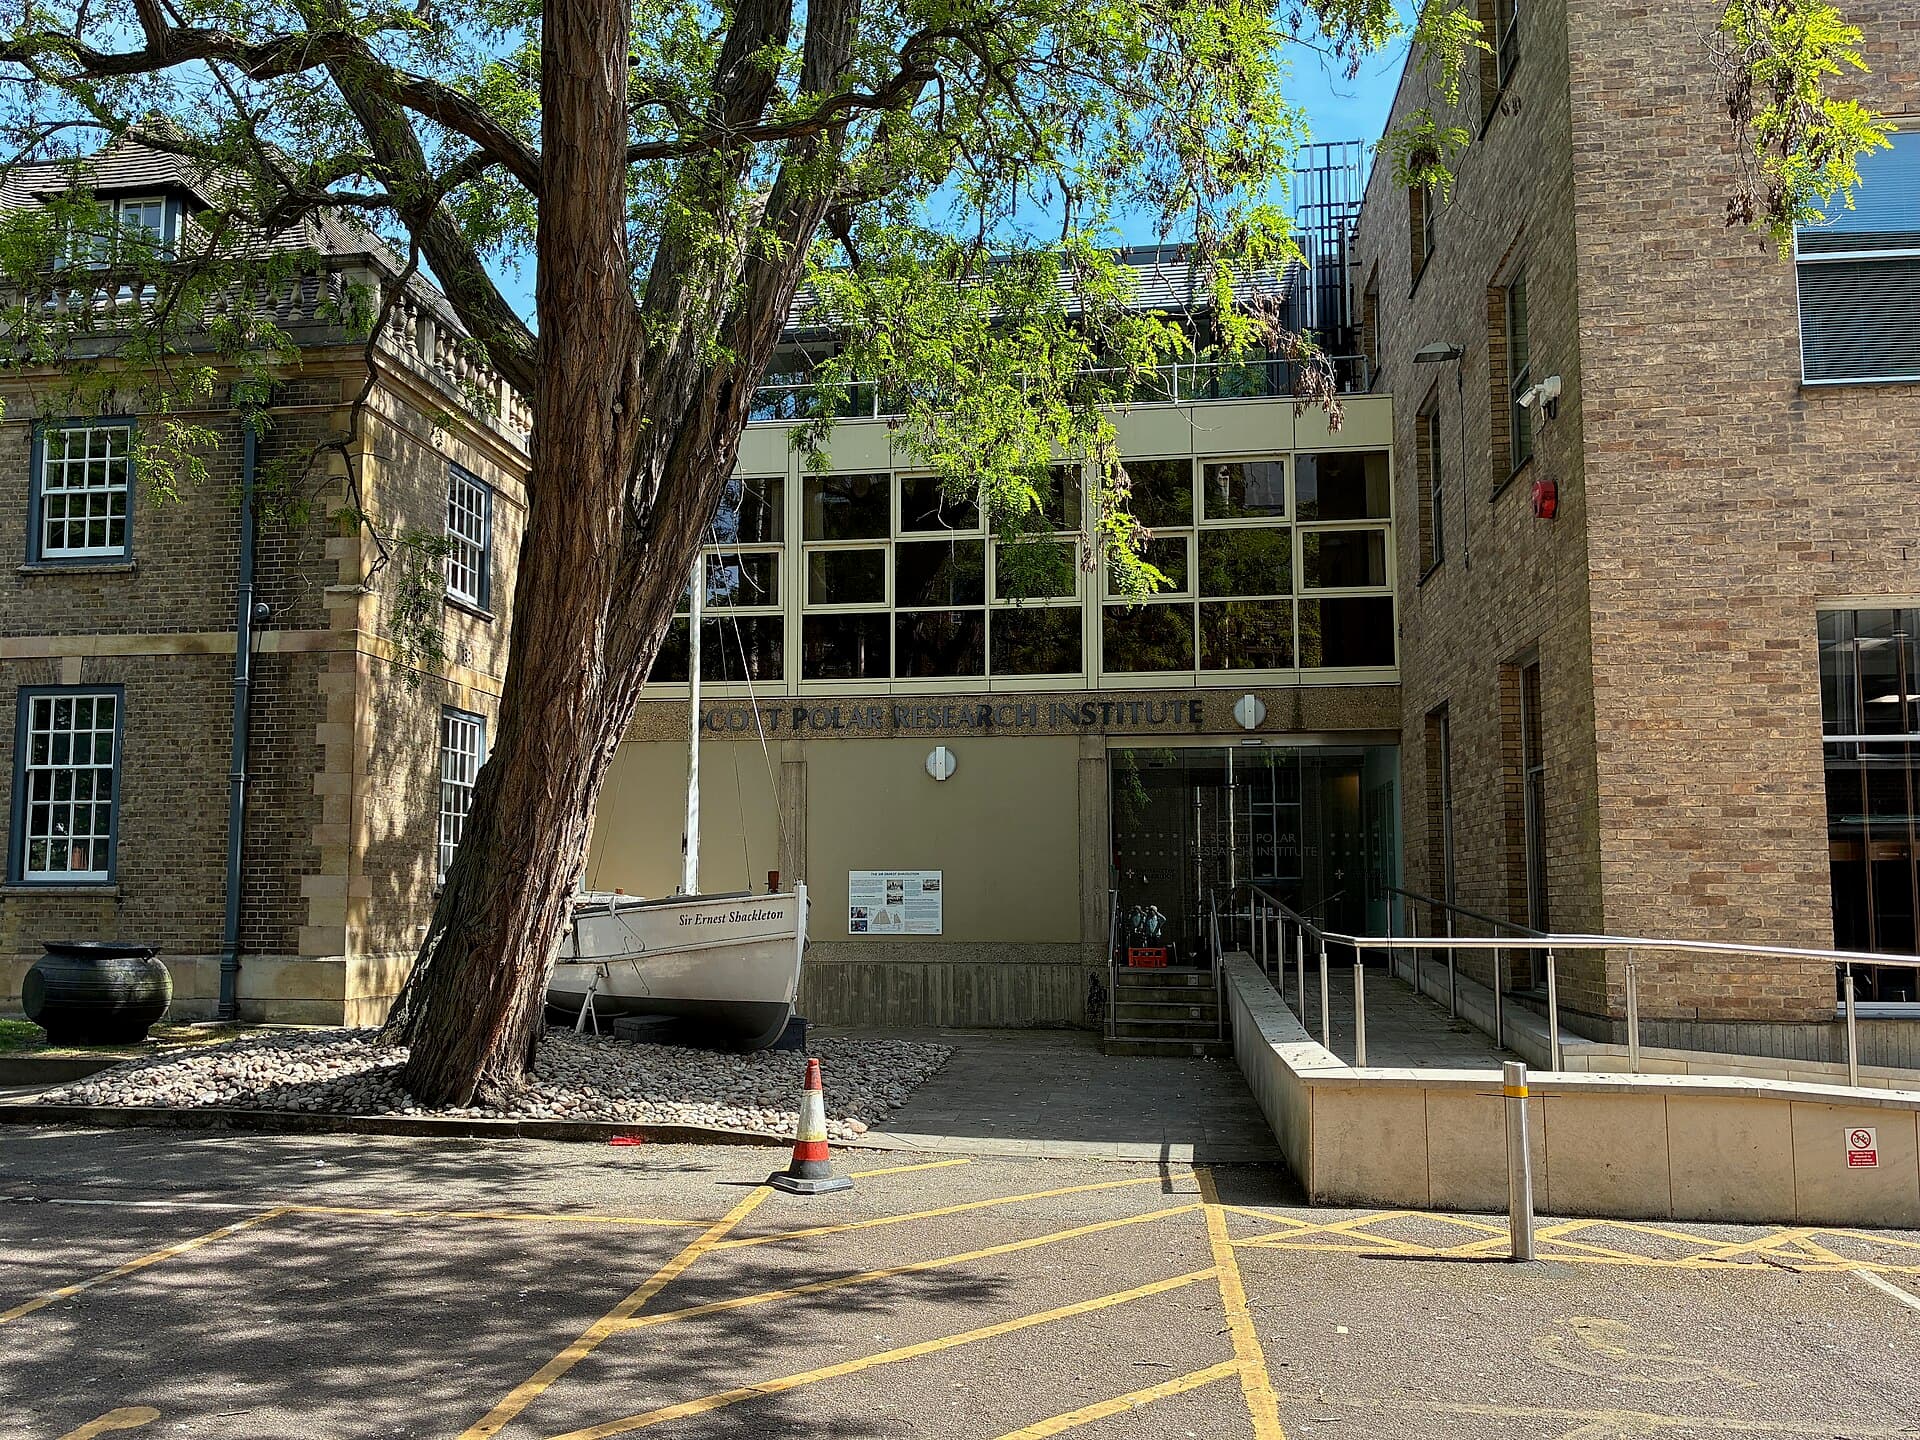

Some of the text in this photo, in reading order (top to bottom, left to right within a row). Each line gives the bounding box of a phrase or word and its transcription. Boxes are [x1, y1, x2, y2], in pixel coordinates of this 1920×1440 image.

[793, 706, 882, 731] POLAR
[894, 703, 1037, 728] RESEARCH
[1050, 700, 1203, 725] INSTITUTE
[1256, 847, 1319, 857] INSTITUTE
[679, 909, 784, 926] Sir Ernest Shackleton
